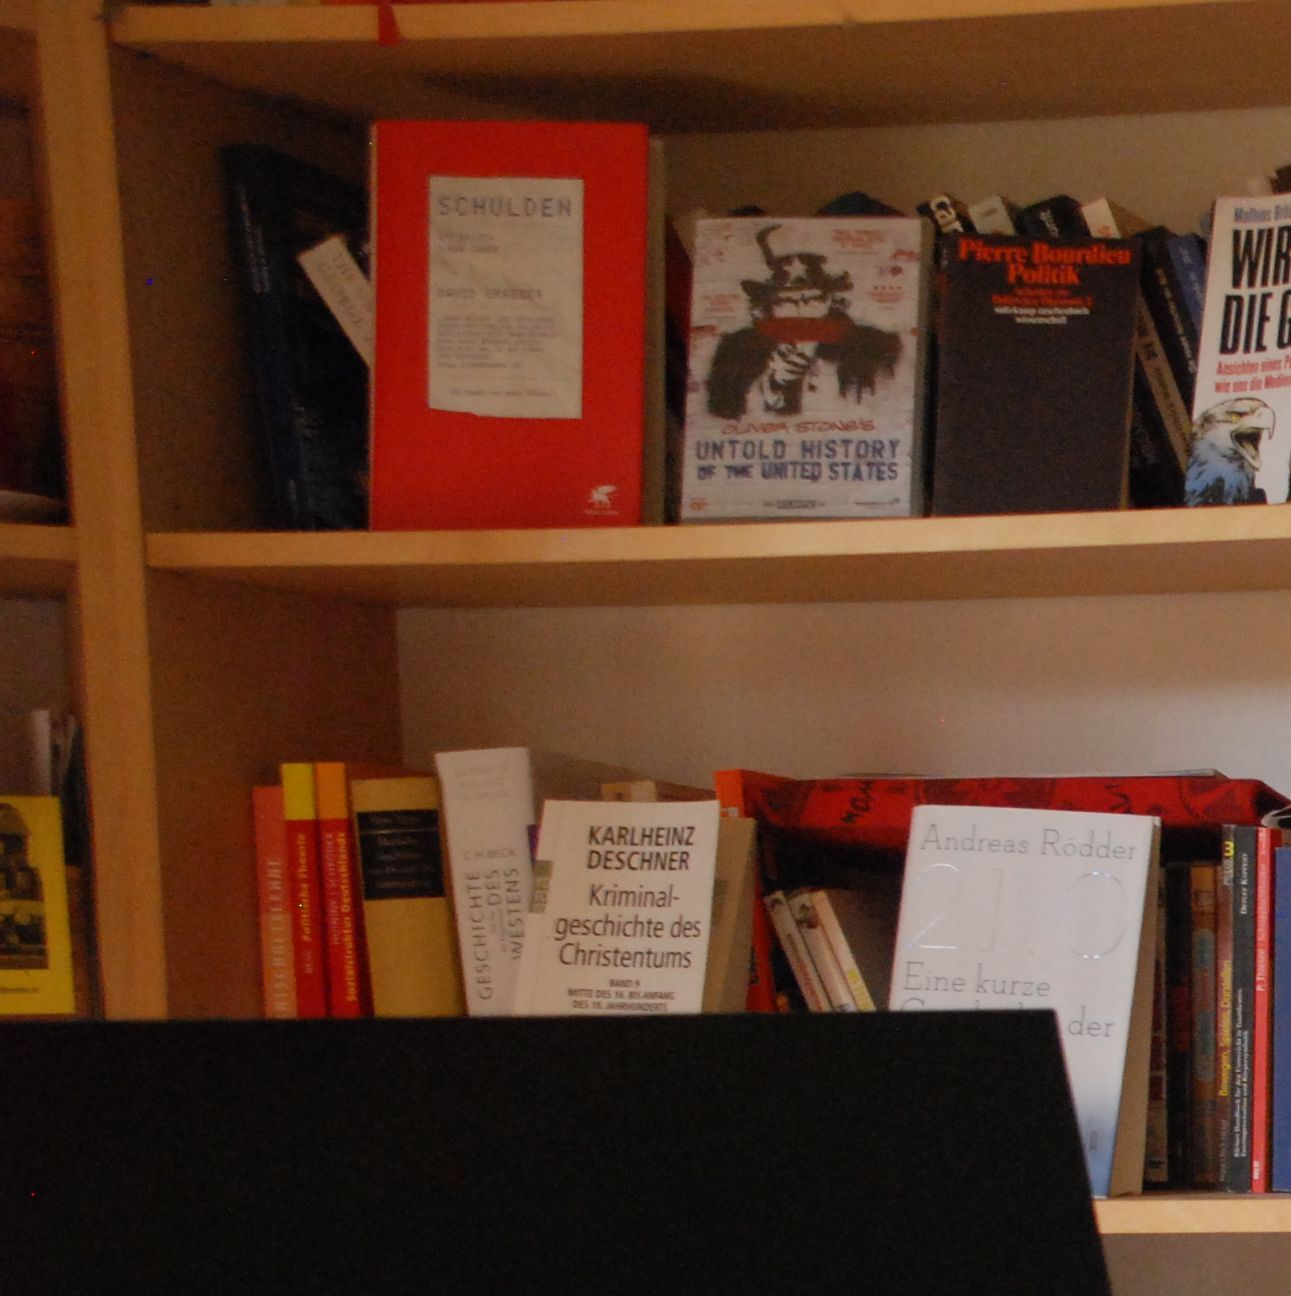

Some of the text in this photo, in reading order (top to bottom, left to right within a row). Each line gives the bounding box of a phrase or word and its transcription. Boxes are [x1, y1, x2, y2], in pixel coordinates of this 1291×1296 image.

[438, 196, 572, 217] SCHULDEN
[959, 236, 1131, 265] Pierre Bourdieu
[1008, 264, 1081, 284] Politik
[1219, 292, 1273, 355] DIE
[696, 439, 900, 460] UNTOLD HISTORY
[761, 461, 822, 482] UNITED
[829, 461, 898, 480] STATES
[588, 826, 695, 846] KARLHEINZ
[920, 824, 1138, 860] Andreas Rödder
[587, 850, 690, 870] DESCHNER
[485, 870, 501, 906] DES
[589, 884, 679, 908] Kriminal-
[504, 868, 524, 961] WESTENS
[555, 913, 701, 940] geschichte des
[465, 871, 492, 999] GESCHICHTE
[559, 942, 691, 968] Christentums
[903, 961, 1051, 996] Eine kurze
[1068, 1006, 1114, 1037] der
